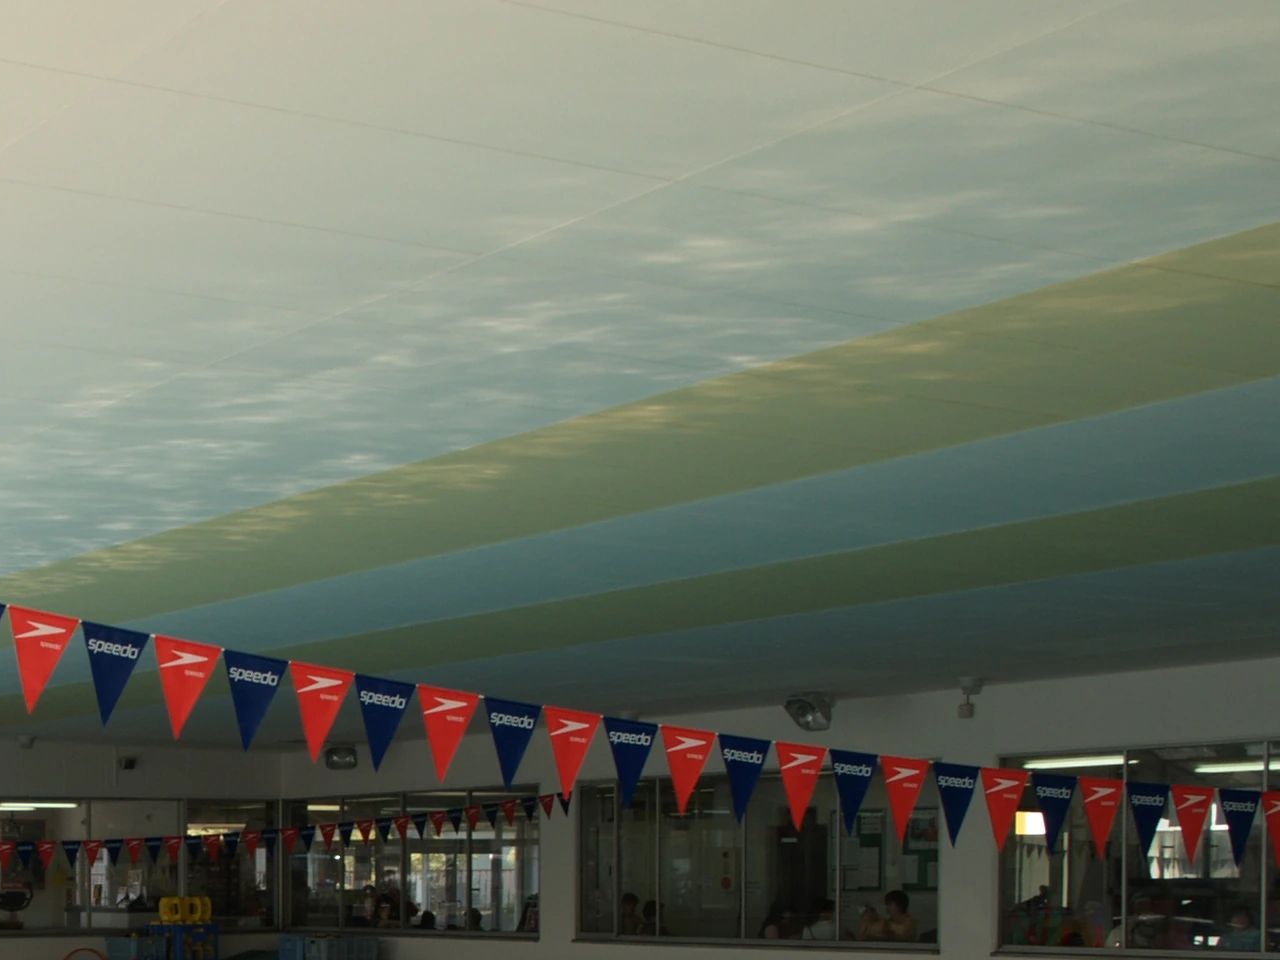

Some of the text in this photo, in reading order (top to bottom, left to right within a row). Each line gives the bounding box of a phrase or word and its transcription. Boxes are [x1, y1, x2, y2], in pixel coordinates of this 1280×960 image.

[88, 638, 139, 659] speedo
[229, 666, 278, 686] speedo
[360, 690, 406, 709] speedo
[490, 712, 534, 729] speedo
[609, 730, 651, 746] speedo
[724, 748, 763, 764] speedo
[834, 762, 871, 777] speedo
[938, 775, 974, 789] speedo
[1036, 786, 1070, 799] speedo
